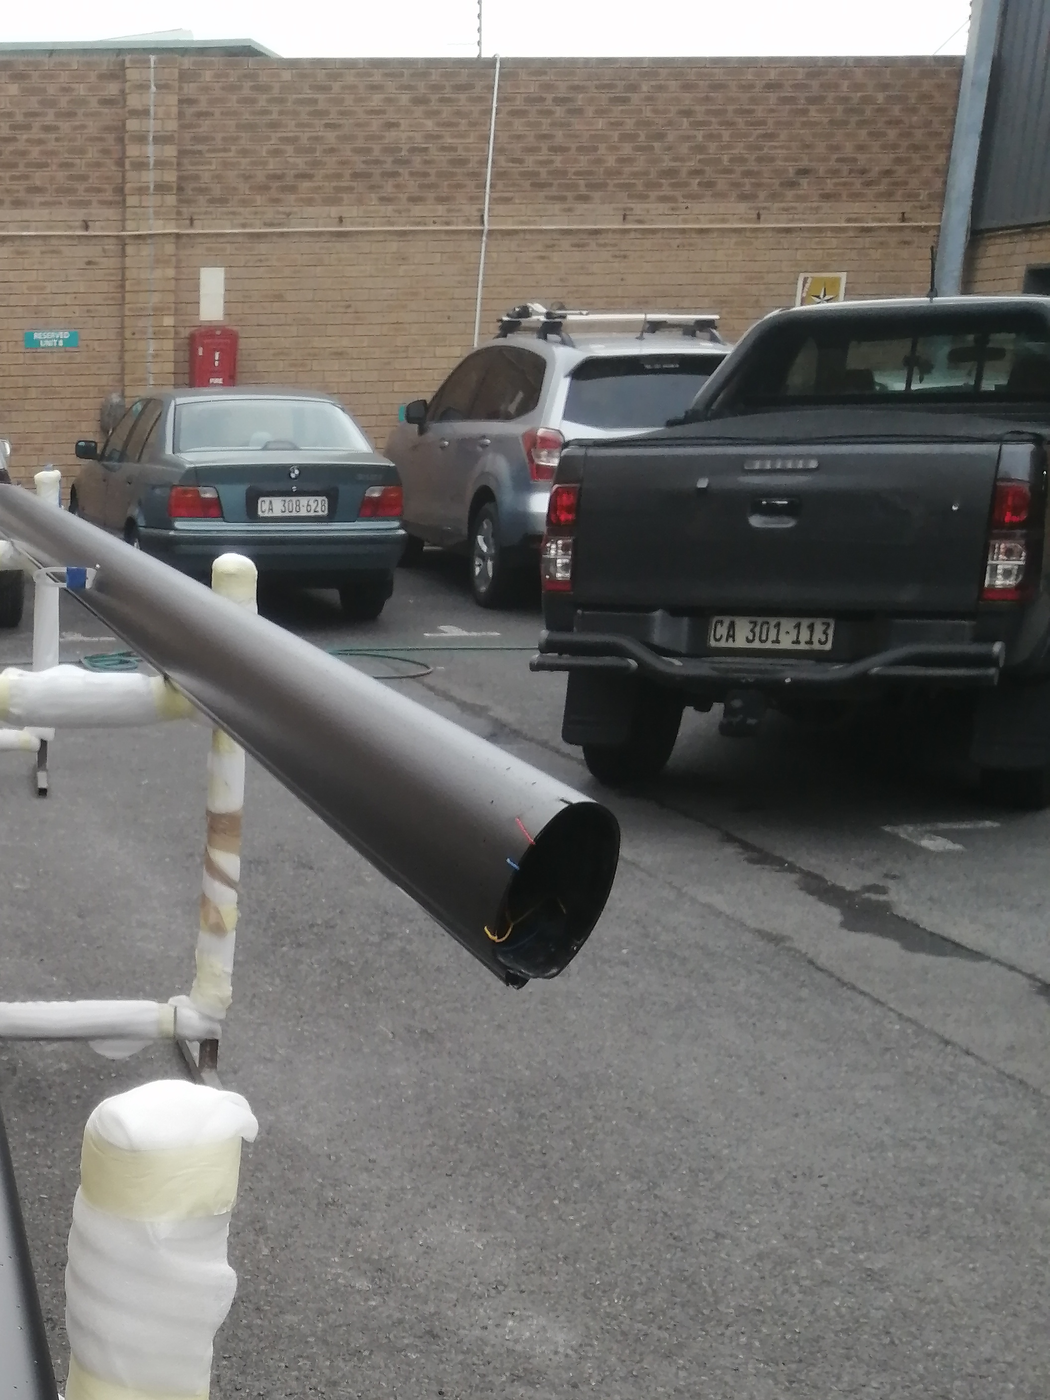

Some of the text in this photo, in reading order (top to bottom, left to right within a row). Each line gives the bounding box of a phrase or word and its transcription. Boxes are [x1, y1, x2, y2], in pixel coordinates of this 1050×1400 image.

[33, 331, 70, 340] RESERVED
[259, 499, 274, 514] CA
[712, 619, 736, 643] CA
